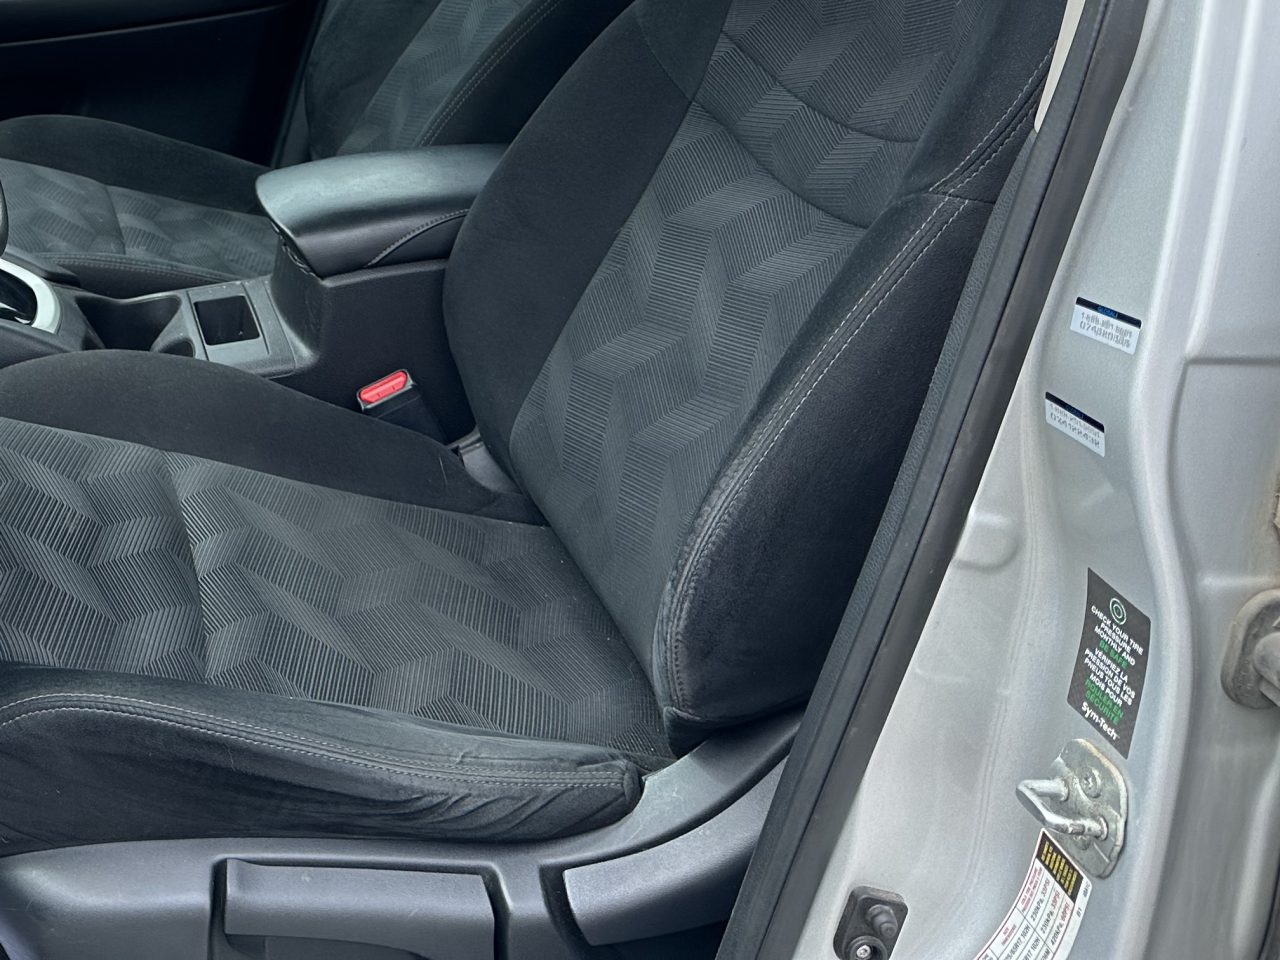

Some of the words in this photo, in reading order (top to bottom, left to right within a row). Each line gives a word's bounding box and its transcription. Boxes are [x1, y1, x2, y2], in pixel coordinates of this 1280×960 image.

[1091, 605, 1112, 627] CHECK
[1112, 624, 1128, 642] YOUR
[1129, 638, 1144, 655] TIRE
[1094, 626, 1122, 653] MONTHLY
[1122, 652, 1136, 666] AND
[1101, 622, 1131, 654] PRESSURE
[1084, 648, 1114, 678] PRESSION
[1114, 676, 1122, 686] DE
[1123, 683, 1136, 698] VOS
[1100, 640, 1108, 652] BE
[1110, 649, 1128, 669] SAFE
[1084, 658, 1104, 678] PNEUS
[1105, 676, 1120, 694] TOUS
[1120, 691, 1132, 706] LES
[1090, 672, 1105, 690] MOIS
[1105, 688, 1122, 707] POUR
[1120, 671, 1128, 683] LA
[1085, 678, 1113, 709] ROULER
[1113, 705, 1124, 718] EN
[1082, 701, 1118, 740] Sym-Tech
